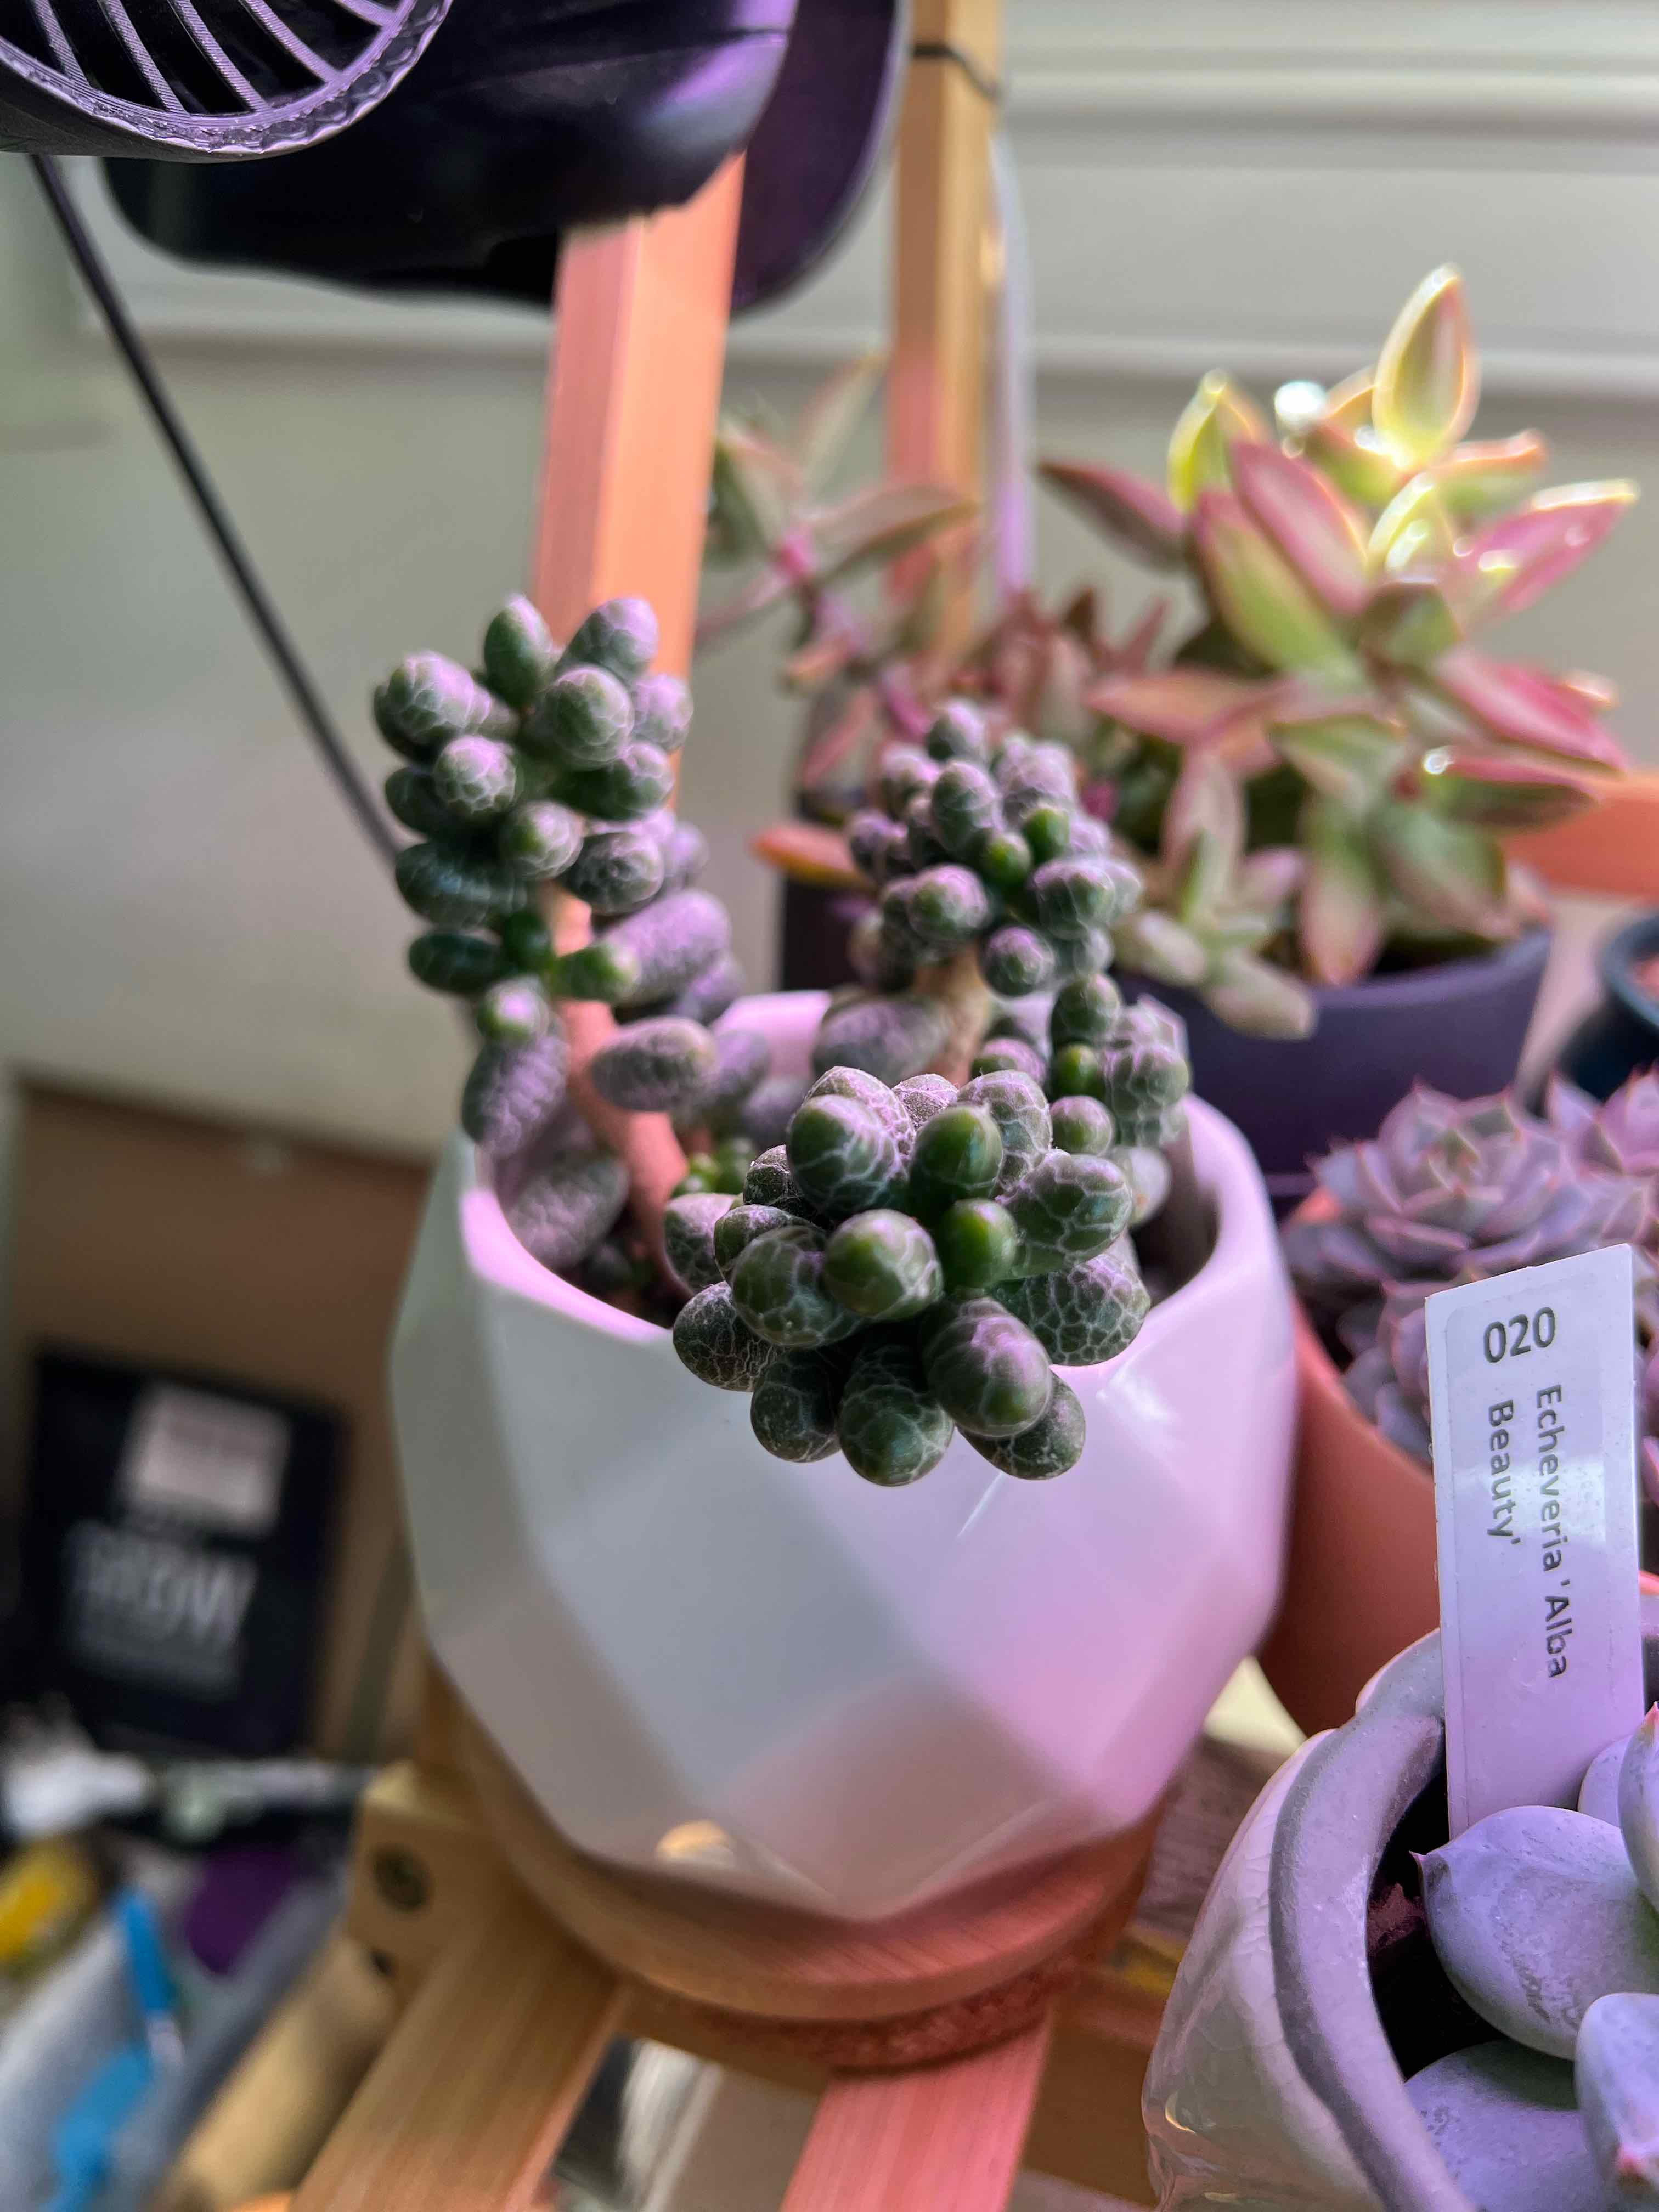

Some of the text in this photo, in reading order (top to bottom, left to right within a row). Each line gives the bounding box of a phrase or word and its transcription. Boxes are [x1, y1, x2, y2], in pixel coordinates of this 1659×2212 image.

[1483, 1306, 1556, 1363] 020
[1487, 1399, 1521, 1545] Beauty'
[1536, 1384, 1568, 1572] Echeveria
